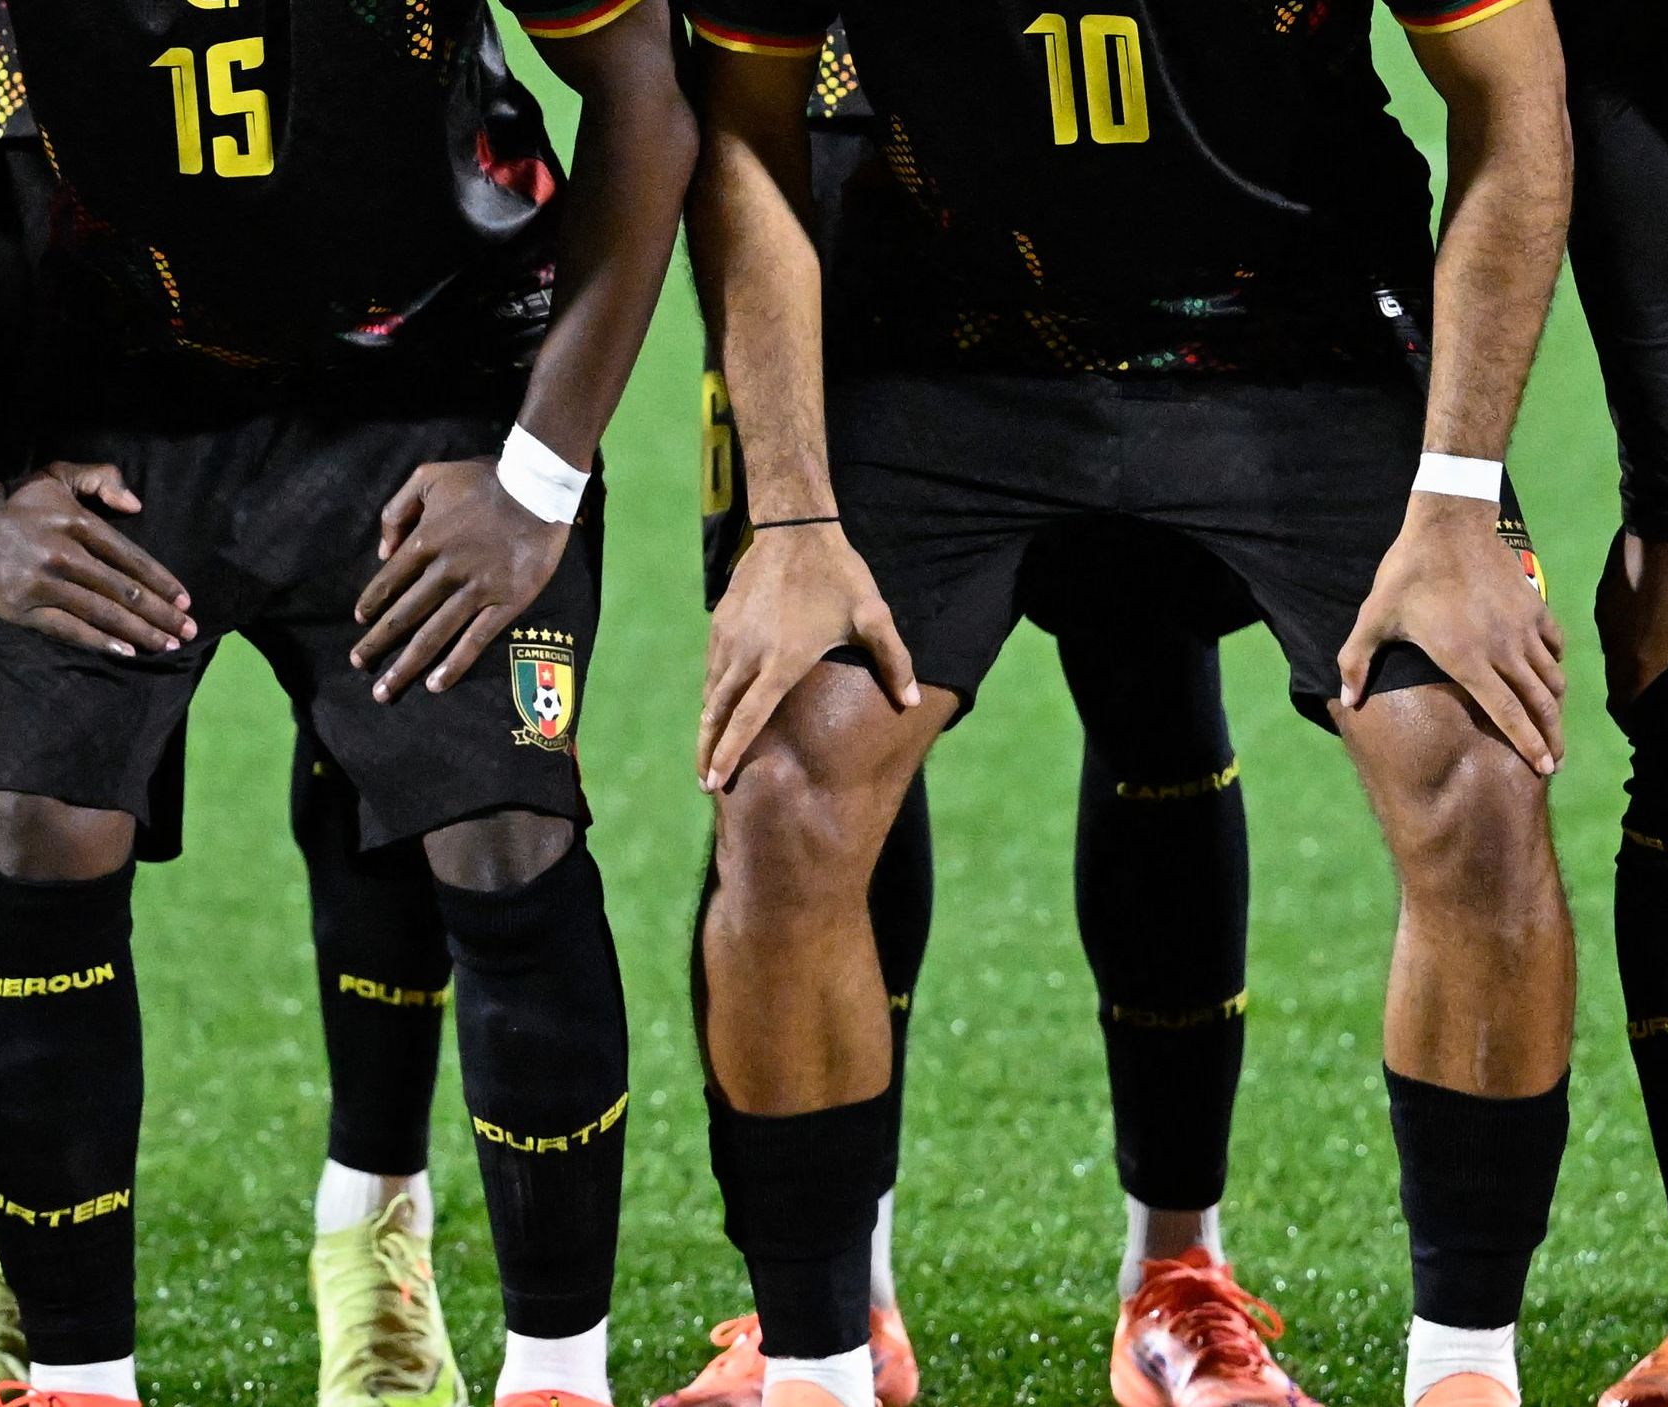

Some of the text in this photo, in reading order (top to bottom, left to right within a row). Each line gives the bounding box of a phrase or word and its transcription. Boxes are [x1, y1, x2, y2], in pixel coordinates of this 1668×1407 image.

[150, 37, 275, 179] 15
[1023, 15, 1150, 146] 10
[516, 649, 570, 662] CAMEROUN
